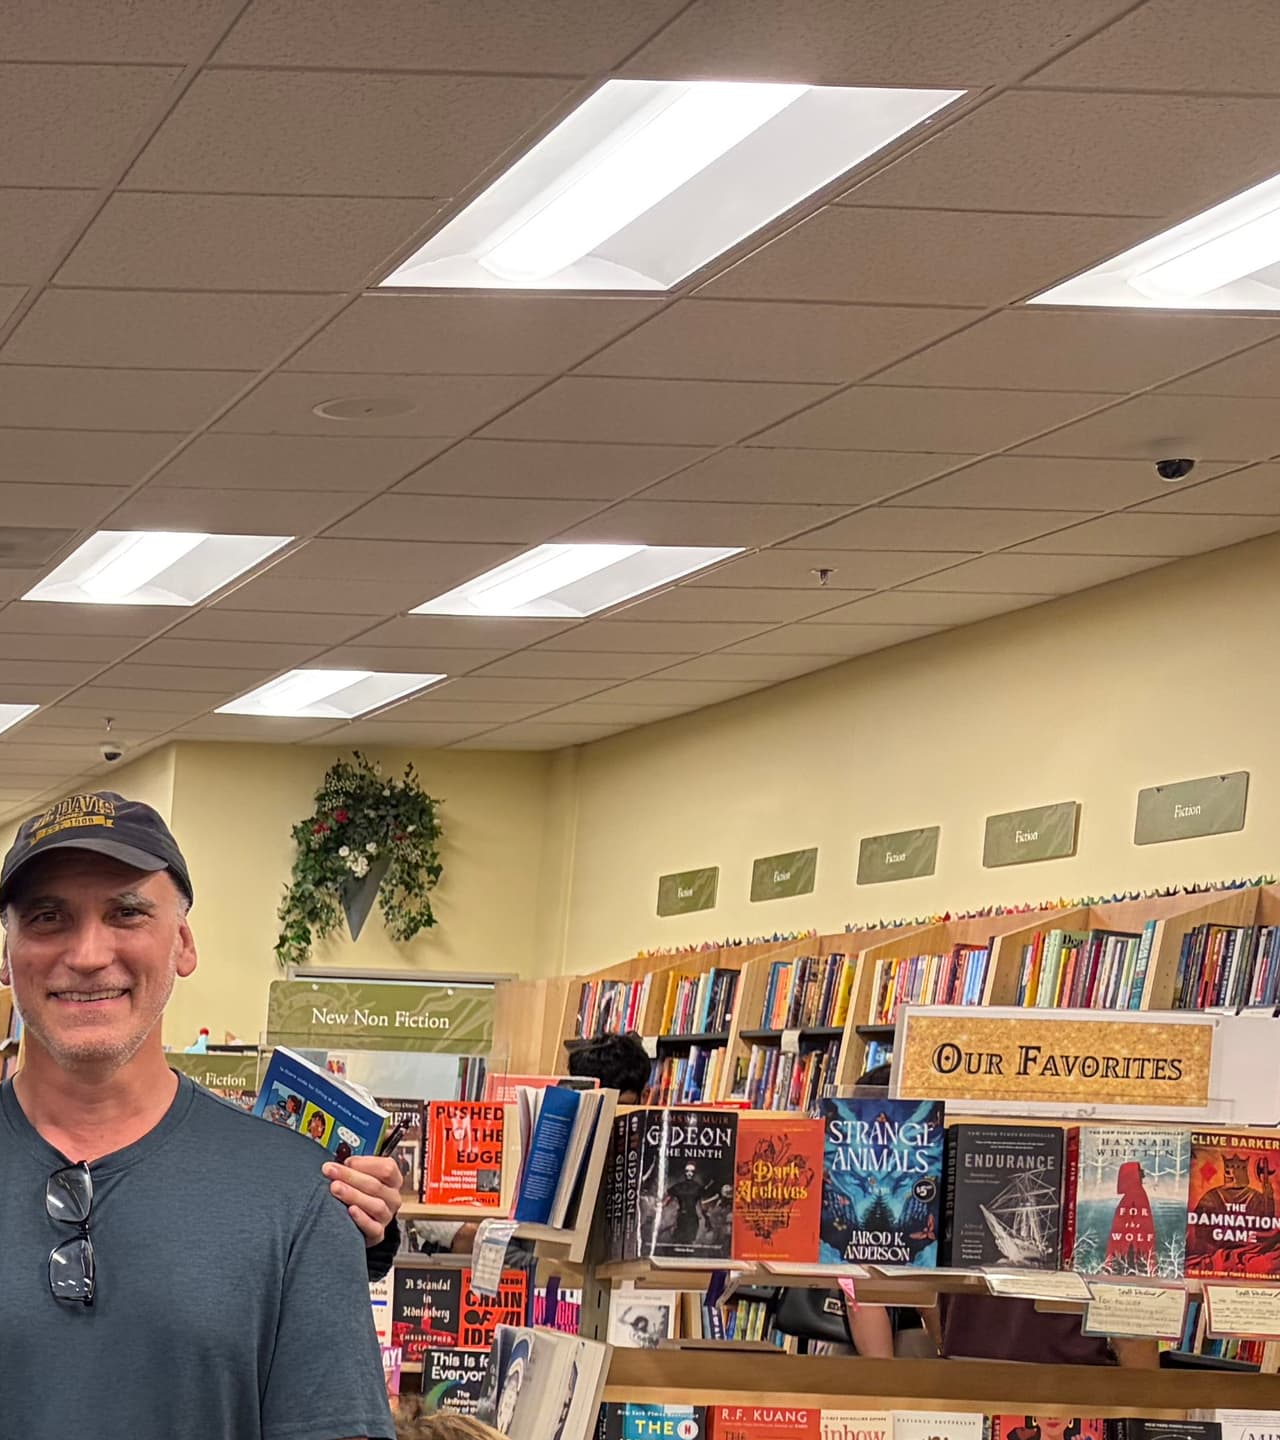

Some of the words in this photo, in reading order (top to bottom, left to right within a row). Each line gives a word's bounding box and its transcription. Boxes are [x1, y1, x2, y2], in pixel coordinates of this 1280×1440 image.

[1174, 804, 1201, 818] Fiction
[1015, 830, 1038, 843] Fiction
[886, 852, 906, 864] Fiction
[312, 1008, 348, 1025] New
[354, 1010, 389, 1027] Non
[395, 1010, 450, 1029] Fiction
[206, 1072, 246, 1087] Fiction
[436, 1106, 504, 1120] PUSHED
[646, 1126, 732, 1148] GDEON
[829, 1118, 935, 1149] STRANGE
[1101, 1137, 1171, 1148] HANNAH
[1191, 1133, 1229, 1146] CLIVE
[1231, 1136, 1280, 1150] BARKER
[456, 1150, 503, 1164] EDGE
[684, 1148, 723, 1159] NINTH
[831, 1147, 929, 1173] ANIMALS
[965, 1153, 1055, 1169] ENDURANCE
[753, 1161, 800, 1180] Dark
[739, 1180, 808, 1202] Archives
[1119, 1207, 1149, 1217] FOR
[1225, 1203, 1247, 1213] THE
[1188, 1211, 1280, 1230] DAMNATION
[848, 1230, 891, 1247] JAROD
[893, 1231, 906, 1246] K.
[1111, 1232, 1155, 1242] WOLF
[1212, 1228, 1258, 1243] GAME
[843, 1246, 911, 1262] ANDERSON
[416, 1278, 451, 1292] Scandal
[431, 1352, 460, 1367] This
[464, 1353, 476, 1367] Is
[721, 1408, 748, 1422] R.F.
[753, 1409, 808, 1423] KUANG
[635, 1420, 673, 1435] THE
